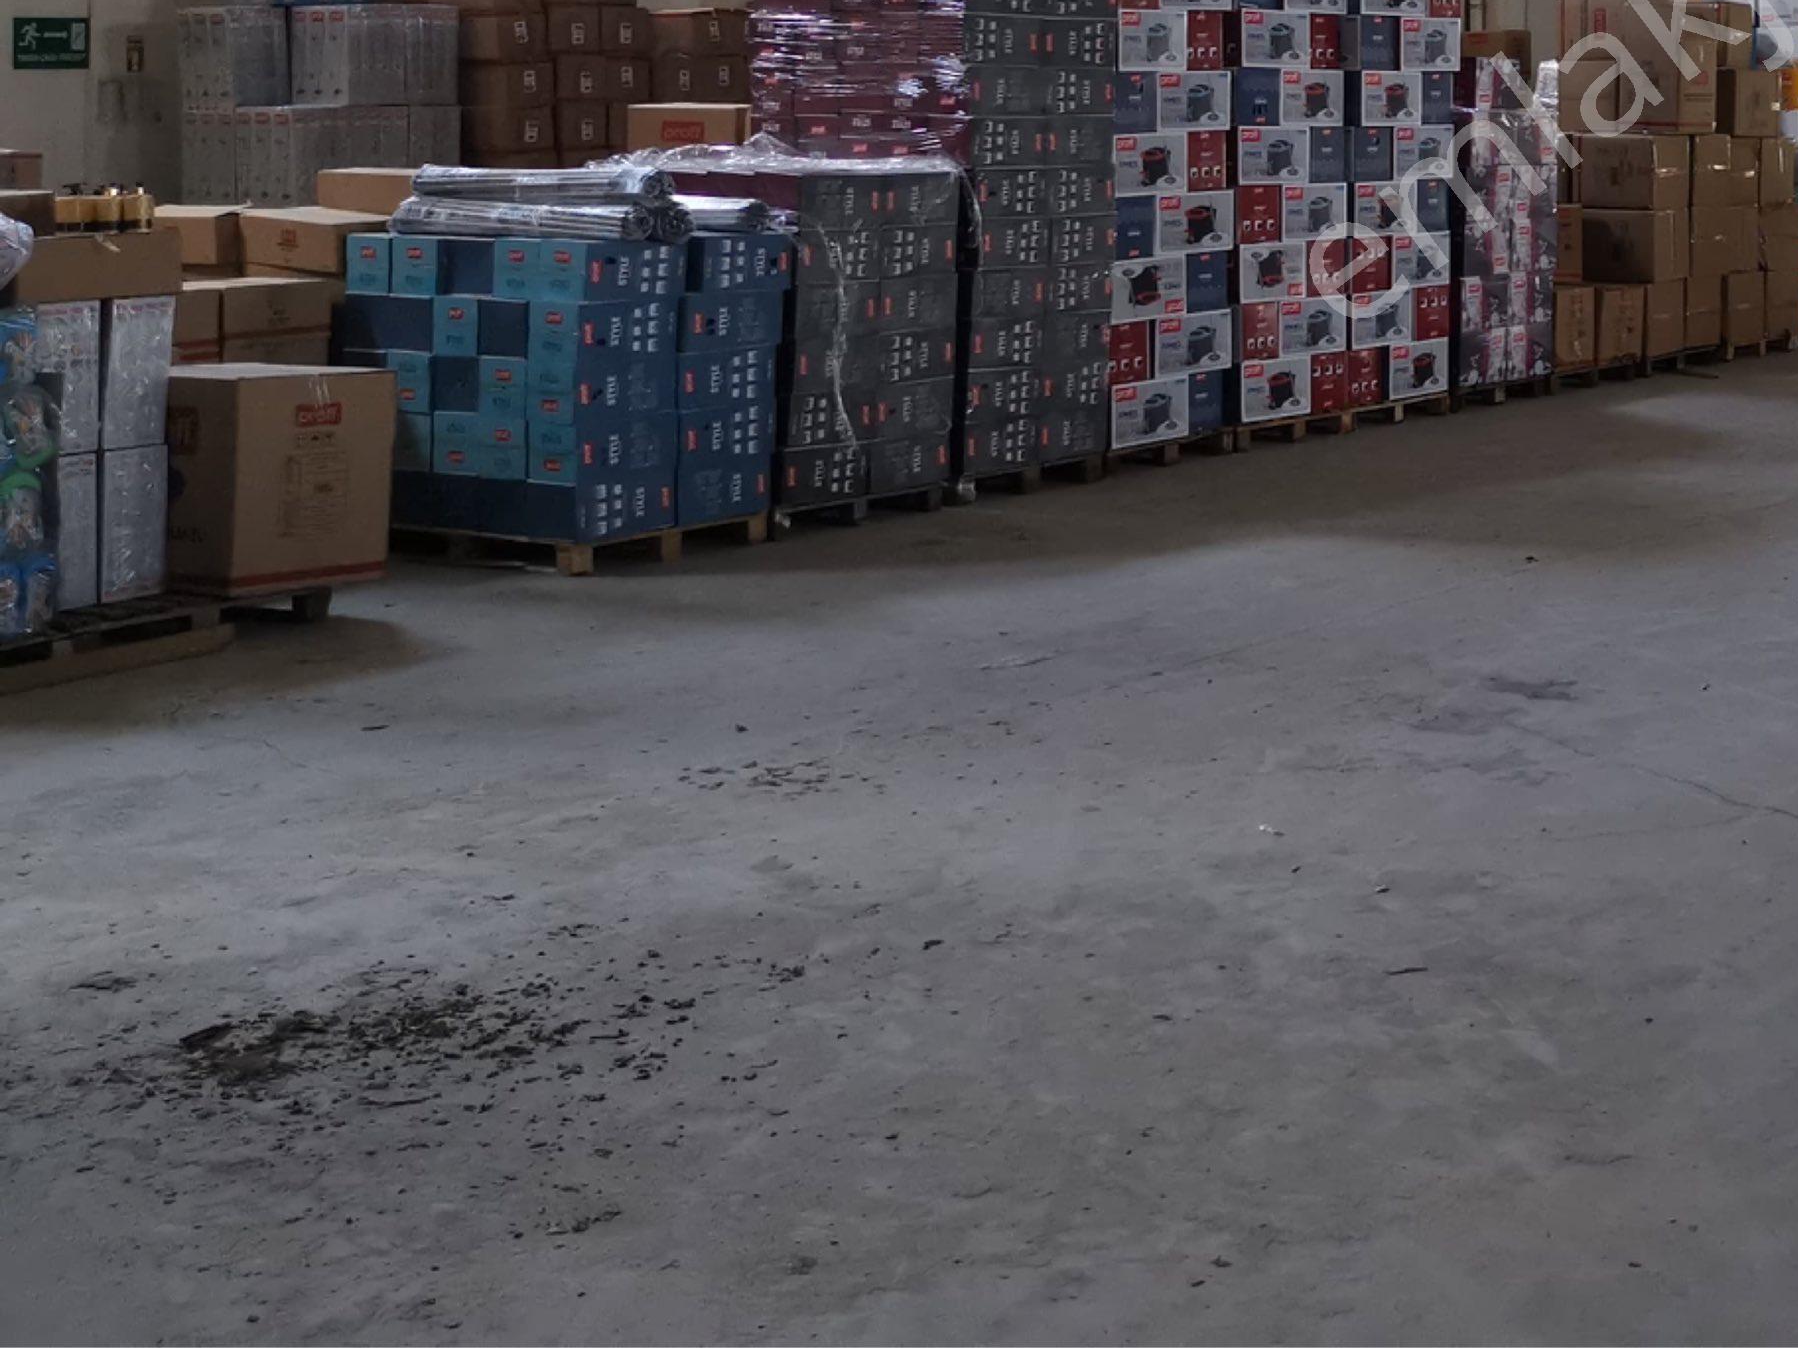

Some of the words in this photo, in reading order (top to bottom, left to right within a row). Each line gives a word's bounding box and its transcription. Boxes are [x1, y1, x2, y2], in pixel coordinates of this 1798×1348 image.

[617, 256, 630, 286] STYLE
[755, 248, 766, 276] STYLE
[609, 317, 622, 347] STYLE
[718, 307, 731, 336] STYLE
[606, 376, 618, 405] STYLE
[710, 365, 722, 394] STYLE
[609, 434, 621, 465] STYLE
[711, 421, 723, 450] STYLE
[635, 487, 645, 517] STYLE
[730, 473, 742, 502] STYLE
